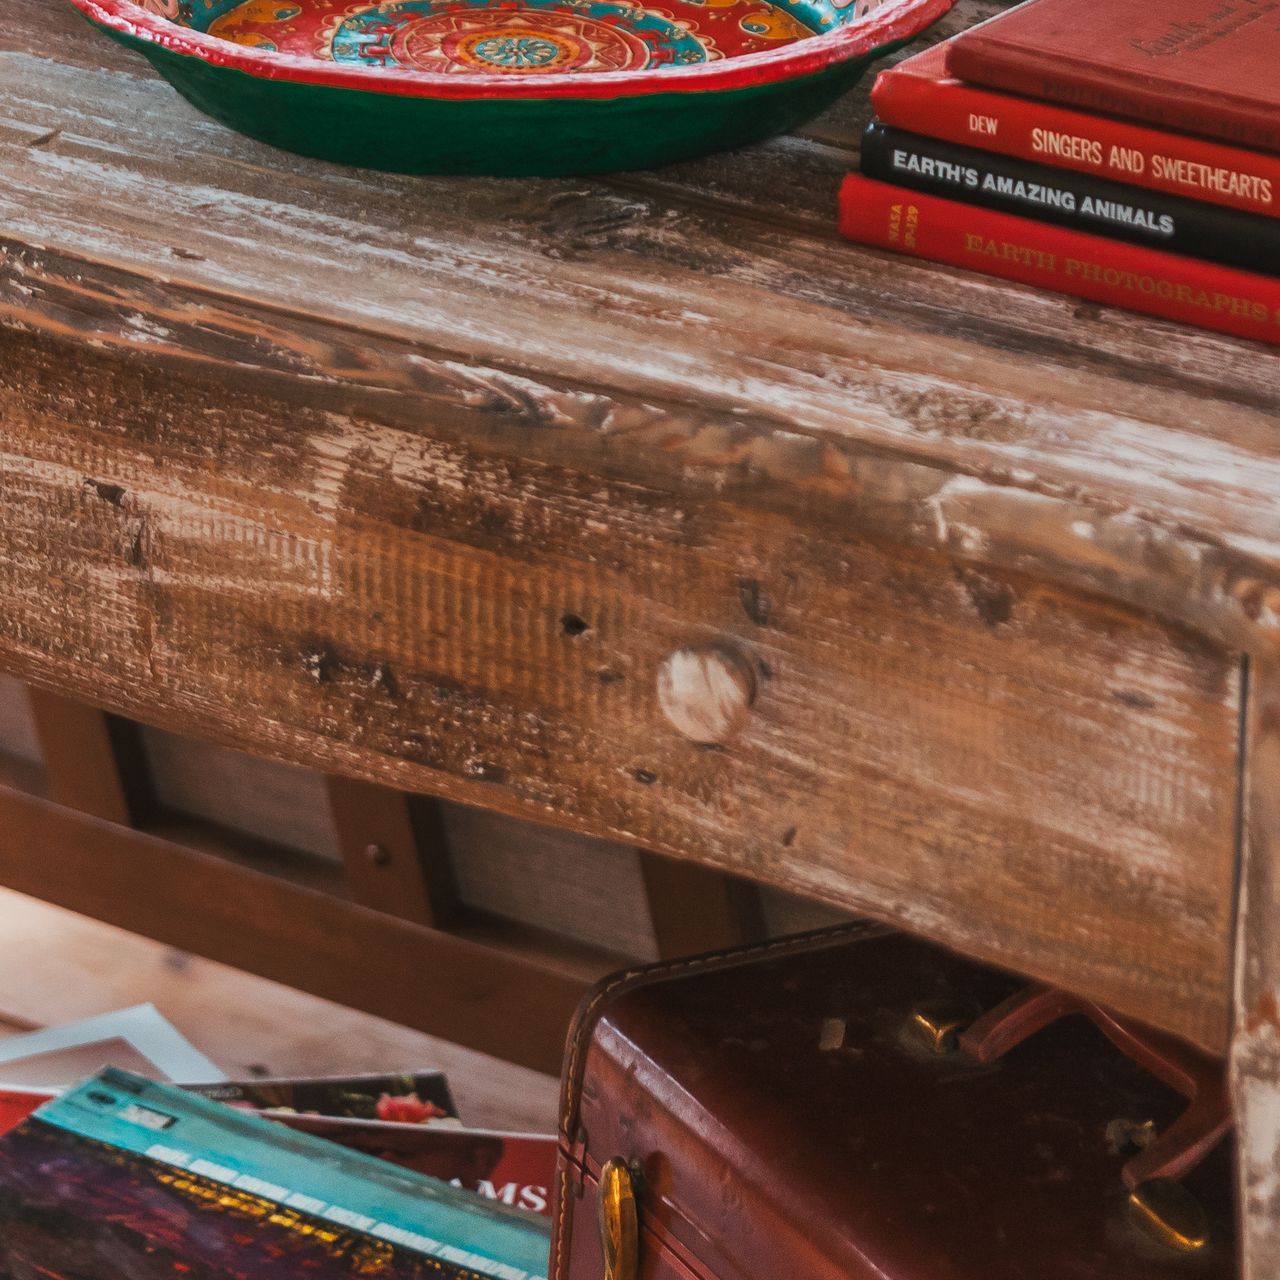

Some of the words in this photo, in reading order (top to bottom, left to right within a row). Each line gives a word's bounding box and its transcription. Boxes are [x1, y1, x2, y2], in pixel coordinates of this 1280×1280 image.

[893, 149, 978, 187] EARTH'S
[982, 173, 1076, 211] AMAZING
[1080, 196, 1175, 236] ANIMALS
[969, 113, 998, 135] DEW
[1032, 128, 1103, 165] SINGERS
[1109, 145, 1145, 174] AND
[1151, 155, 1273, 203] SWEETHEARTS
[888, 205, 903, 241] NASA
[964, 233, 1057, 271] EARTH
[1065, 258, 1269, 322] PHOTOGRAPHS
